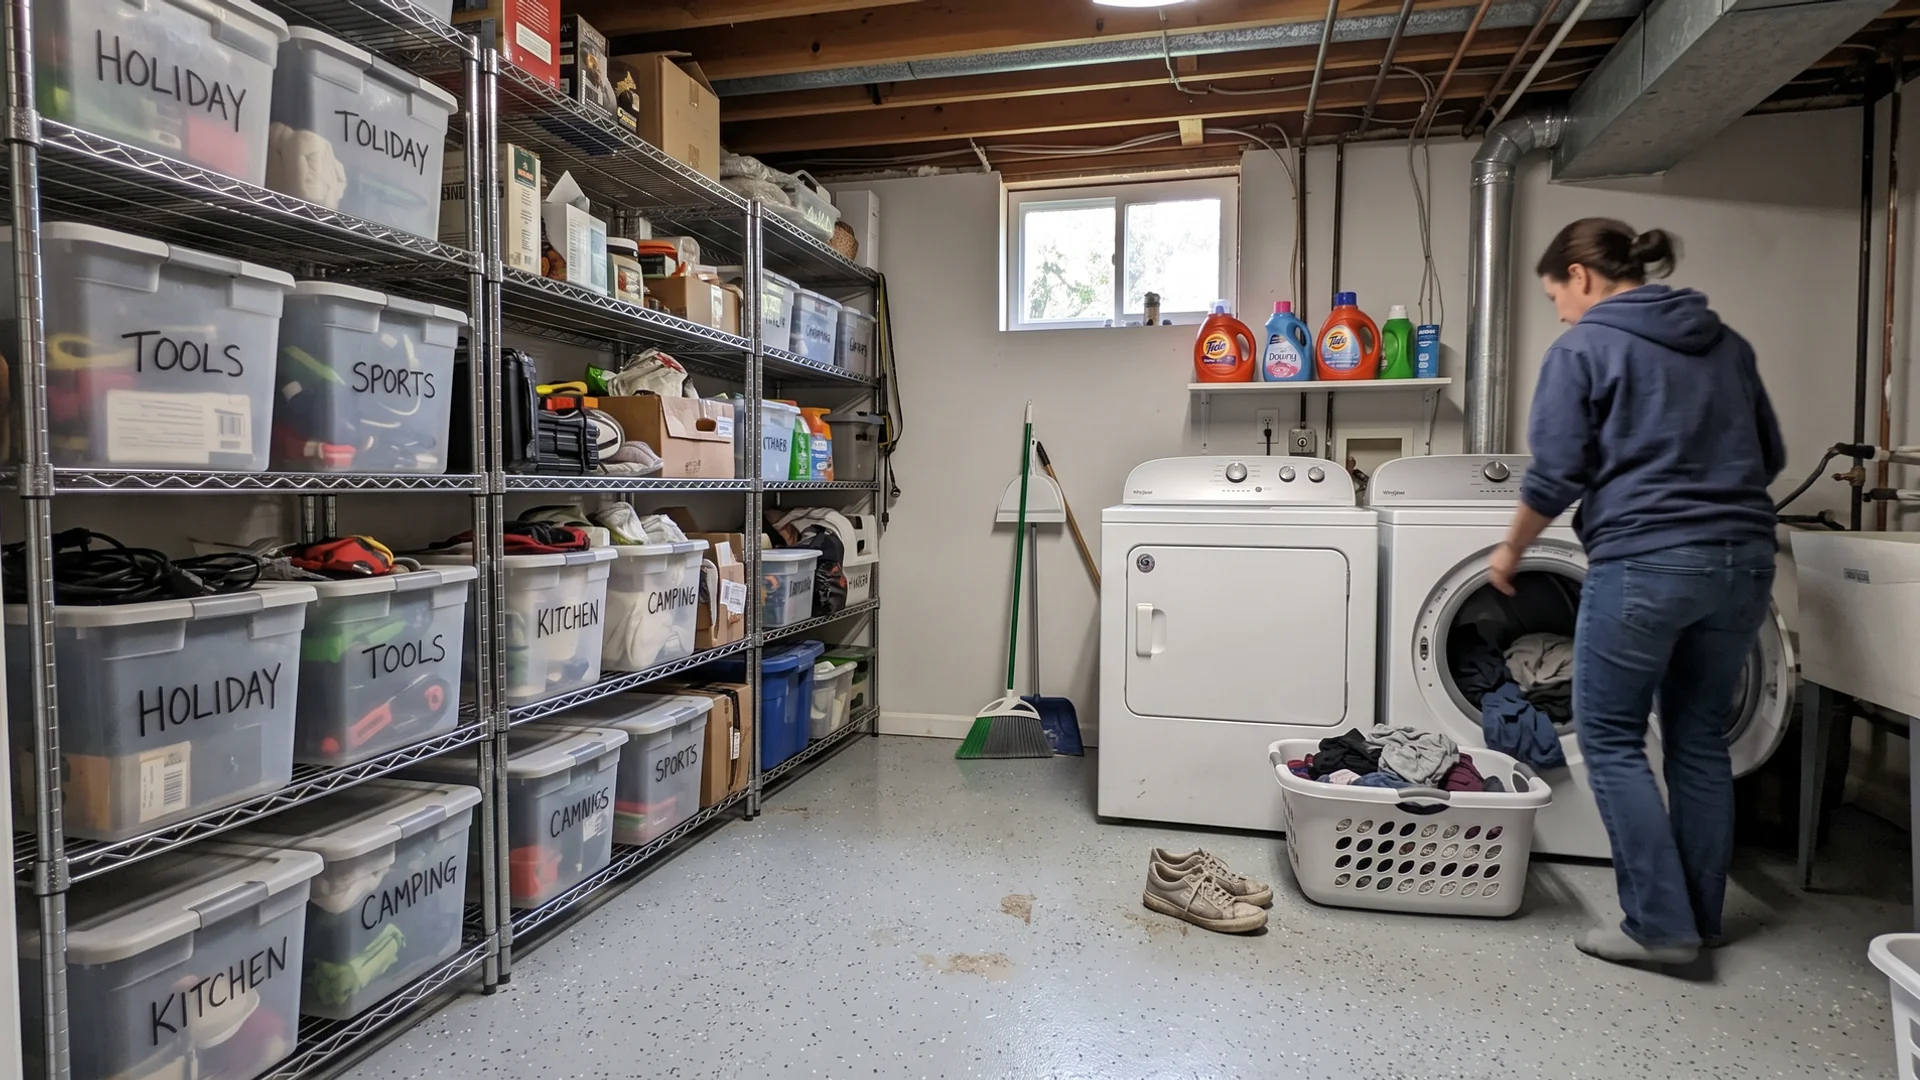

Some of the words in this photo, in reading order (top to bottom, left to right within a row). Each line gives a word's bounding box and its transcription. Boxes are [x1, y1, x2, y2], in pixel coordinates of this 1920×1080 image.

[96, 29, 247, 133] HOLIDAY
[335, 110, 430, 176] TOLIDAY
[121, 330, 244, 378] TOOLS
[1206, 340, 1226, 354] Tide
[1269, 352, 1297, 362] Downy
[352, 361, 437, 399] SPORTS
[537, 599, 599, 640] KITCHEN
[647, 586, 697, 616] CAMPING
[362, 634, 446, 680] TOOLS
[137, 662, 282, 737] HOLIDAY
[655, 743, 698, 783] SPORTS
[360, 855, 457, 931] CAMPING
[151, 936, 288, 1046] KITCHEN
